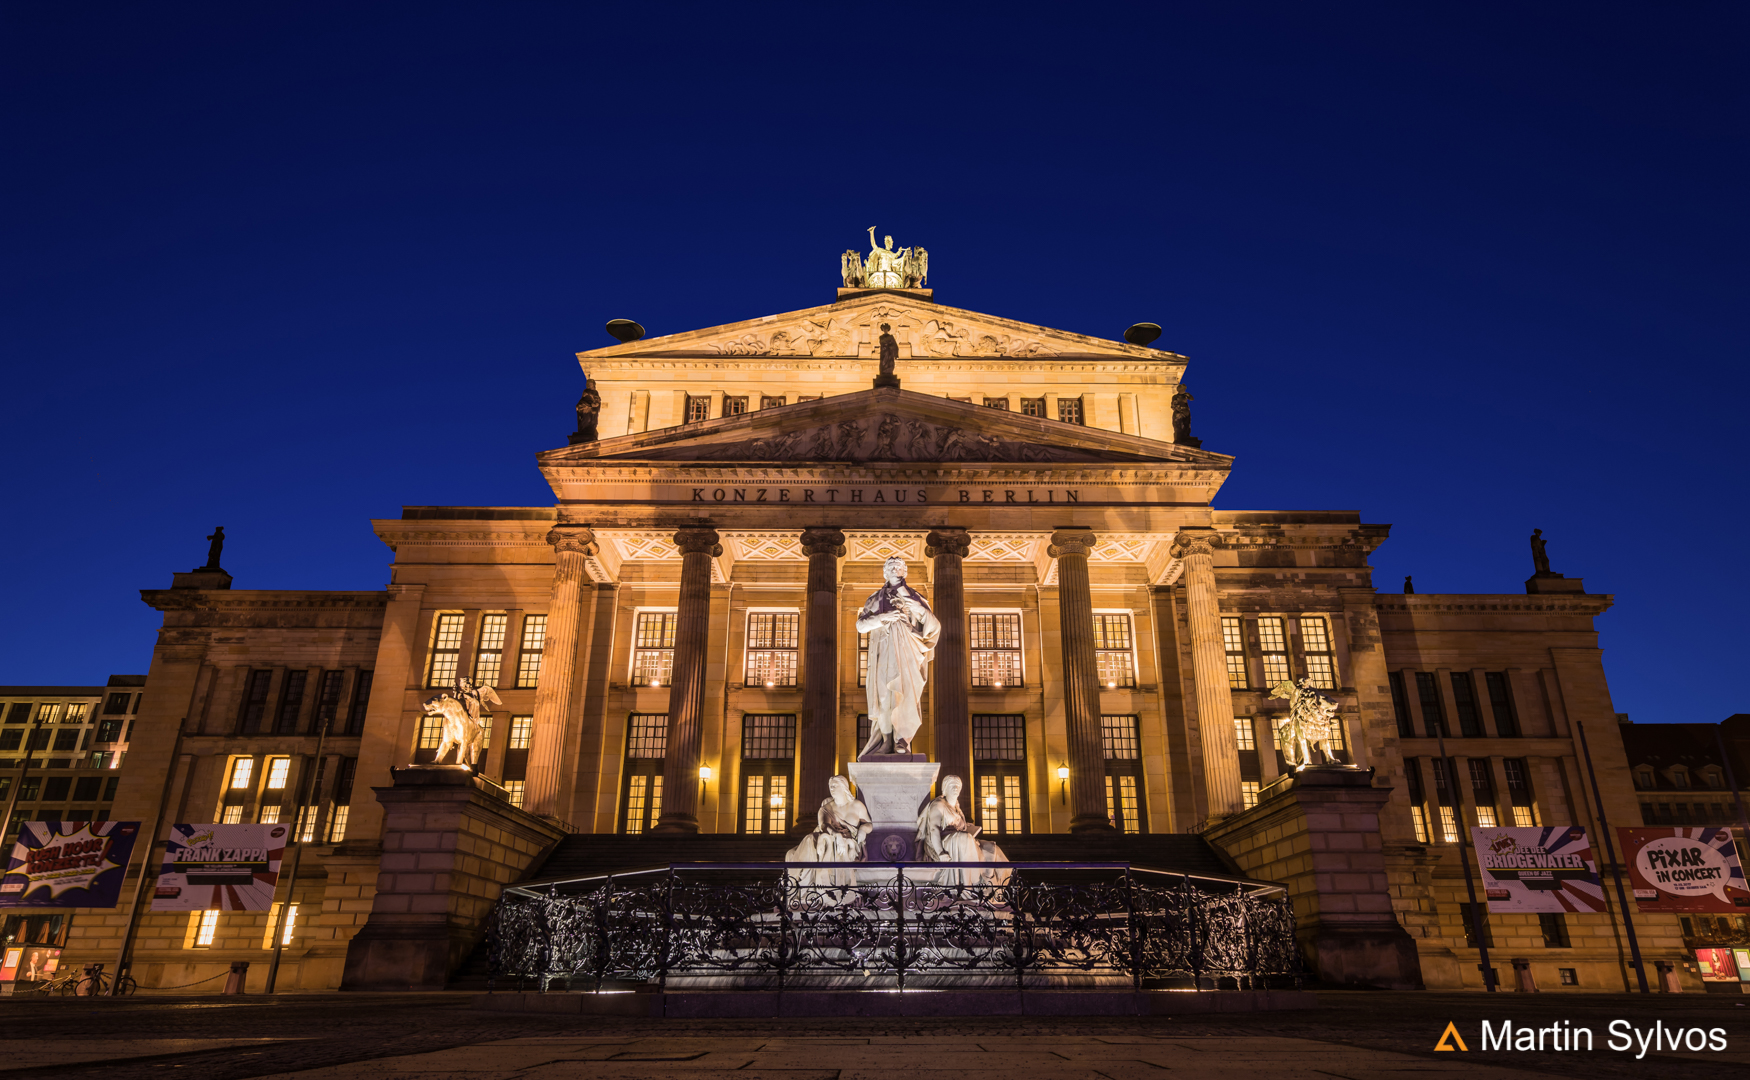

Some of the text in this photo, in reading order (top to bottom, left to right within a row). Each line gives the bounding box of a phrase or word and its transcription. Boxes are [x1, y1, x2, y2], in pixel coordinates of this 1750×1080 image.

[692, 488, 1078, 503] KONZERTHAUS BERLIN
[25, 839, 103, 863] RUSH HOUR
[174, 848, 268, 862] FRANK ZAPPA
[1530, 846, 1546, 854] DEE
[1485, 854, 1584, 868] BRIDGEWATER
[1671, 867, 1721, 882] CONCERT
